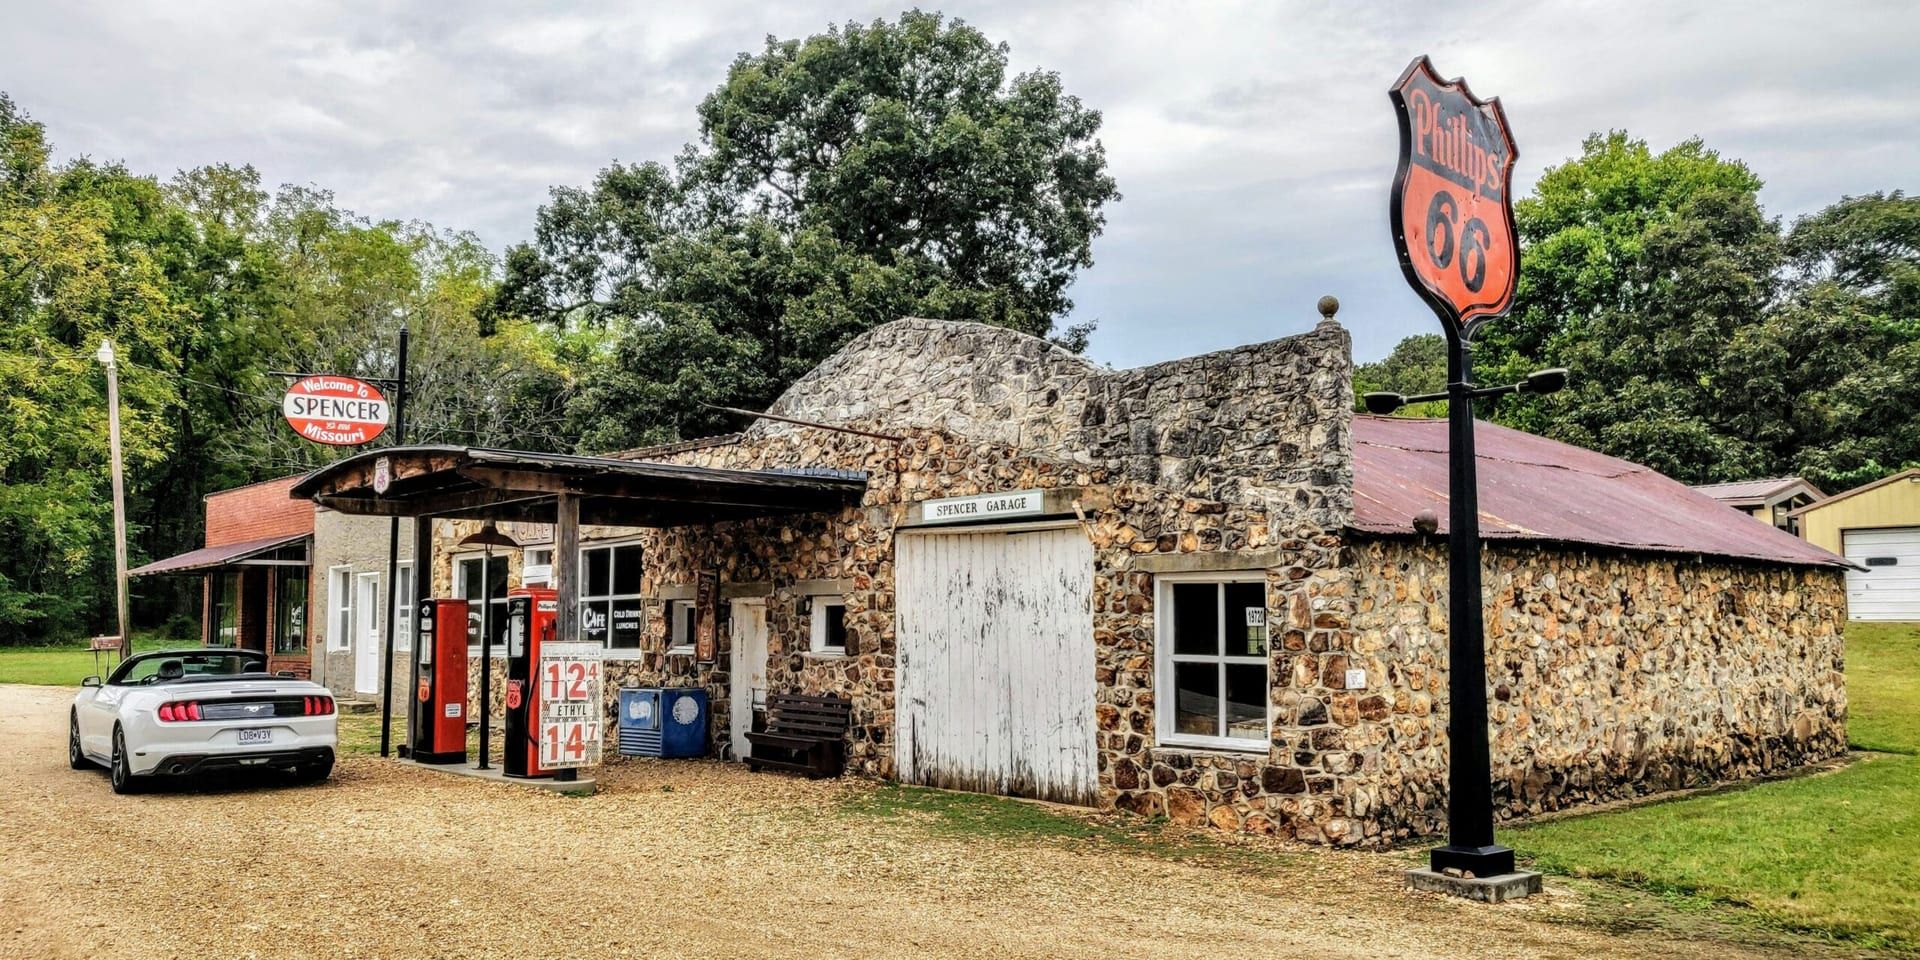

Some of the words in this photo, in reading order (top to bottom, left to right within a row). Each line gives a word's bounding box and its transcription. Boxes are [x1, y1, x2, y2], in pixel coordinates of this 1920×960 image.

[1410, 89, 1501, 201] Phillips
[1426, 190, 1490, 293] 66
[302, 378, 354, 393] Welcome
[357, 382, 368, 398] To
[293, 397, 380, 420] SPENCER
[304, 423, 364, 442] Missouri
[937, 502, 977, 516] SPENCER
[987, 497, 1027, 512] GARAGE
[583, 608, 605, 628] CAFE
[614, 610, 625, 618] COLD
[557, 705, 586, 716] ETHYL
